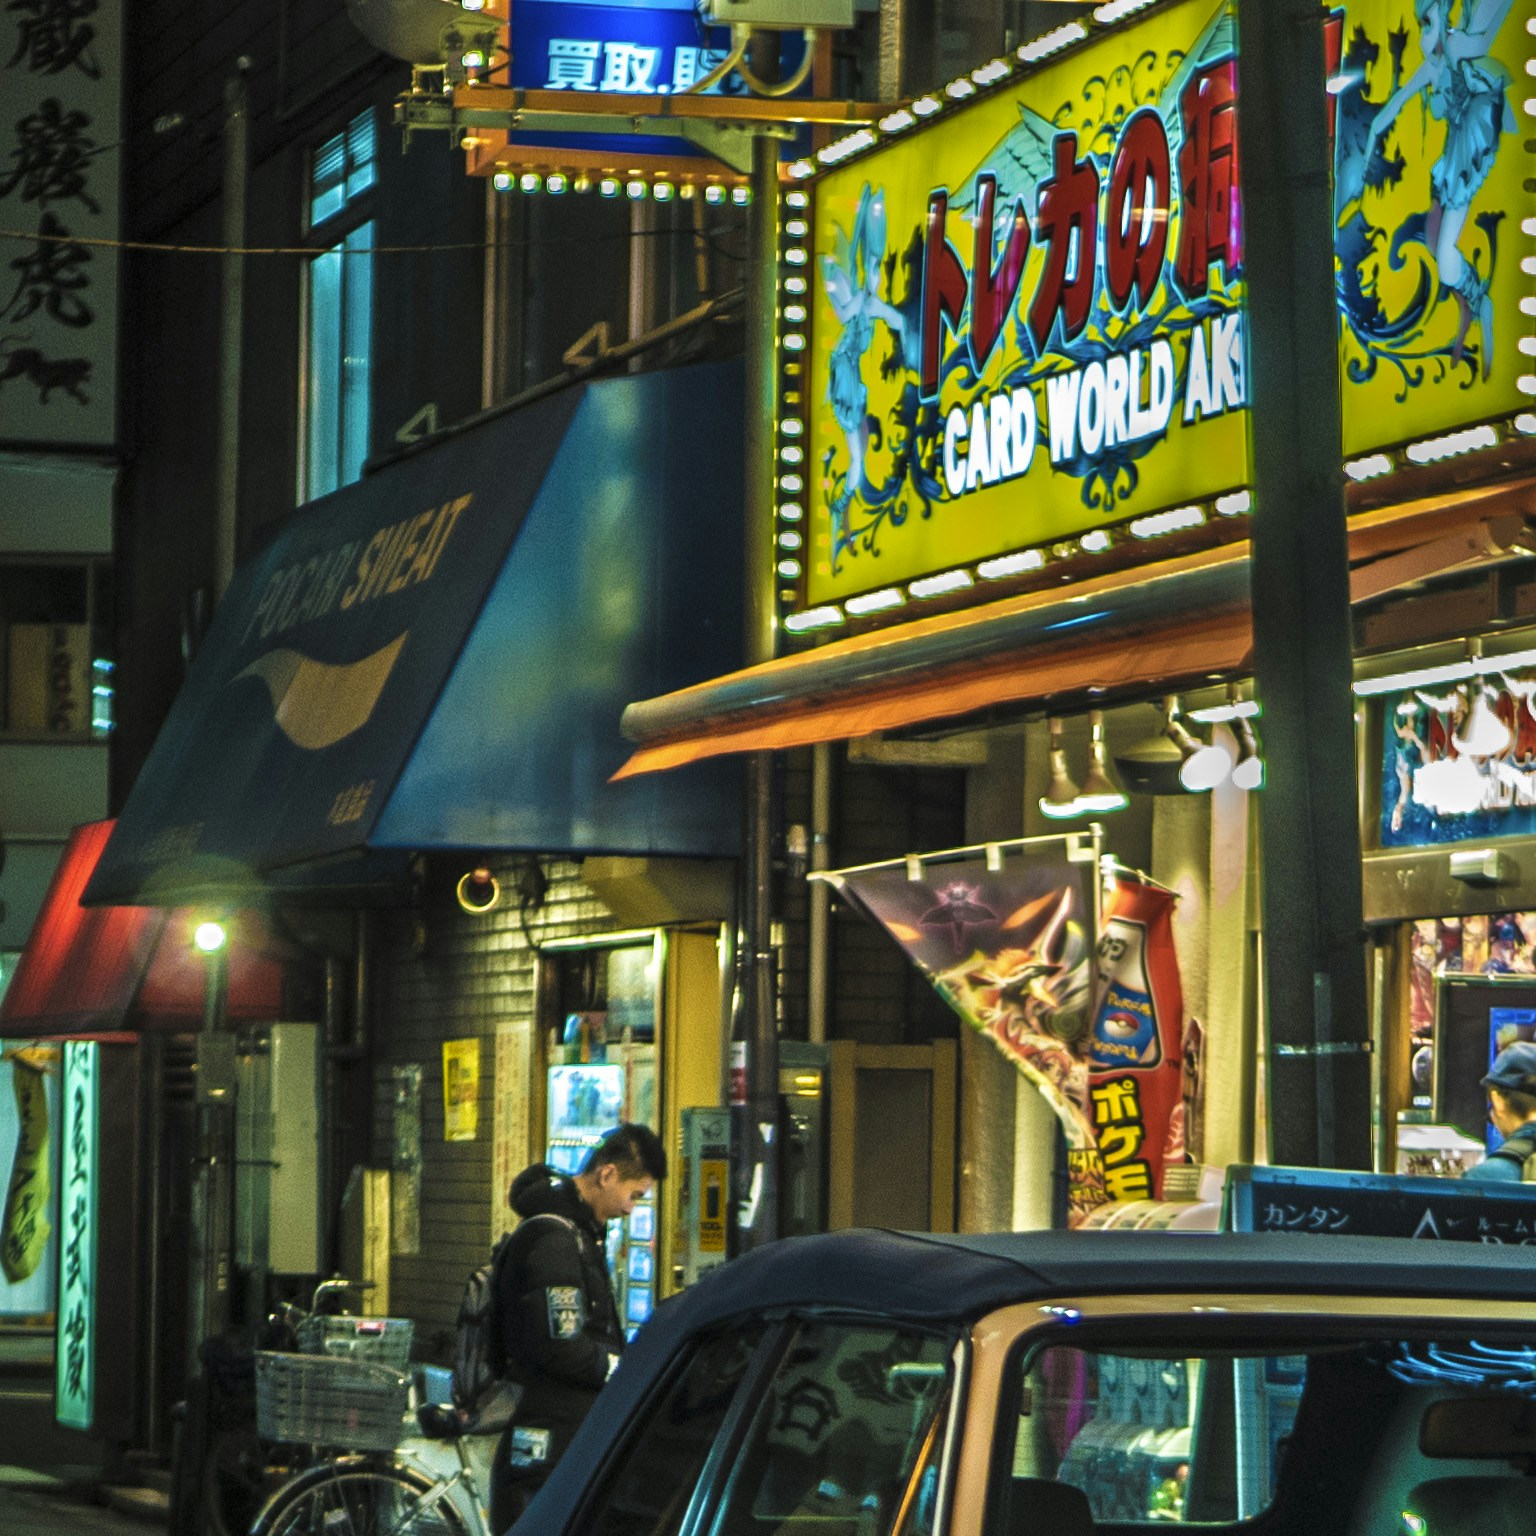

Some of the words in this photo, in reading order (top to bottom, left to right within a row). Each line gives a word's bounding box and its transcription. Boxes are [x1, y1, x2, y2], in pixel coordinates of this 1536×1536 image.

[919, 8, 1346, 404] トレカの洞
[944, 399, 1038, 497] CARD
[1048, 336, 1177, 465] WORLD
[1183, 313, 1246, 425] AK
[340, 492, 474, 611] SWEAT
[1263, 1203, 1350, 1229] カンタン
